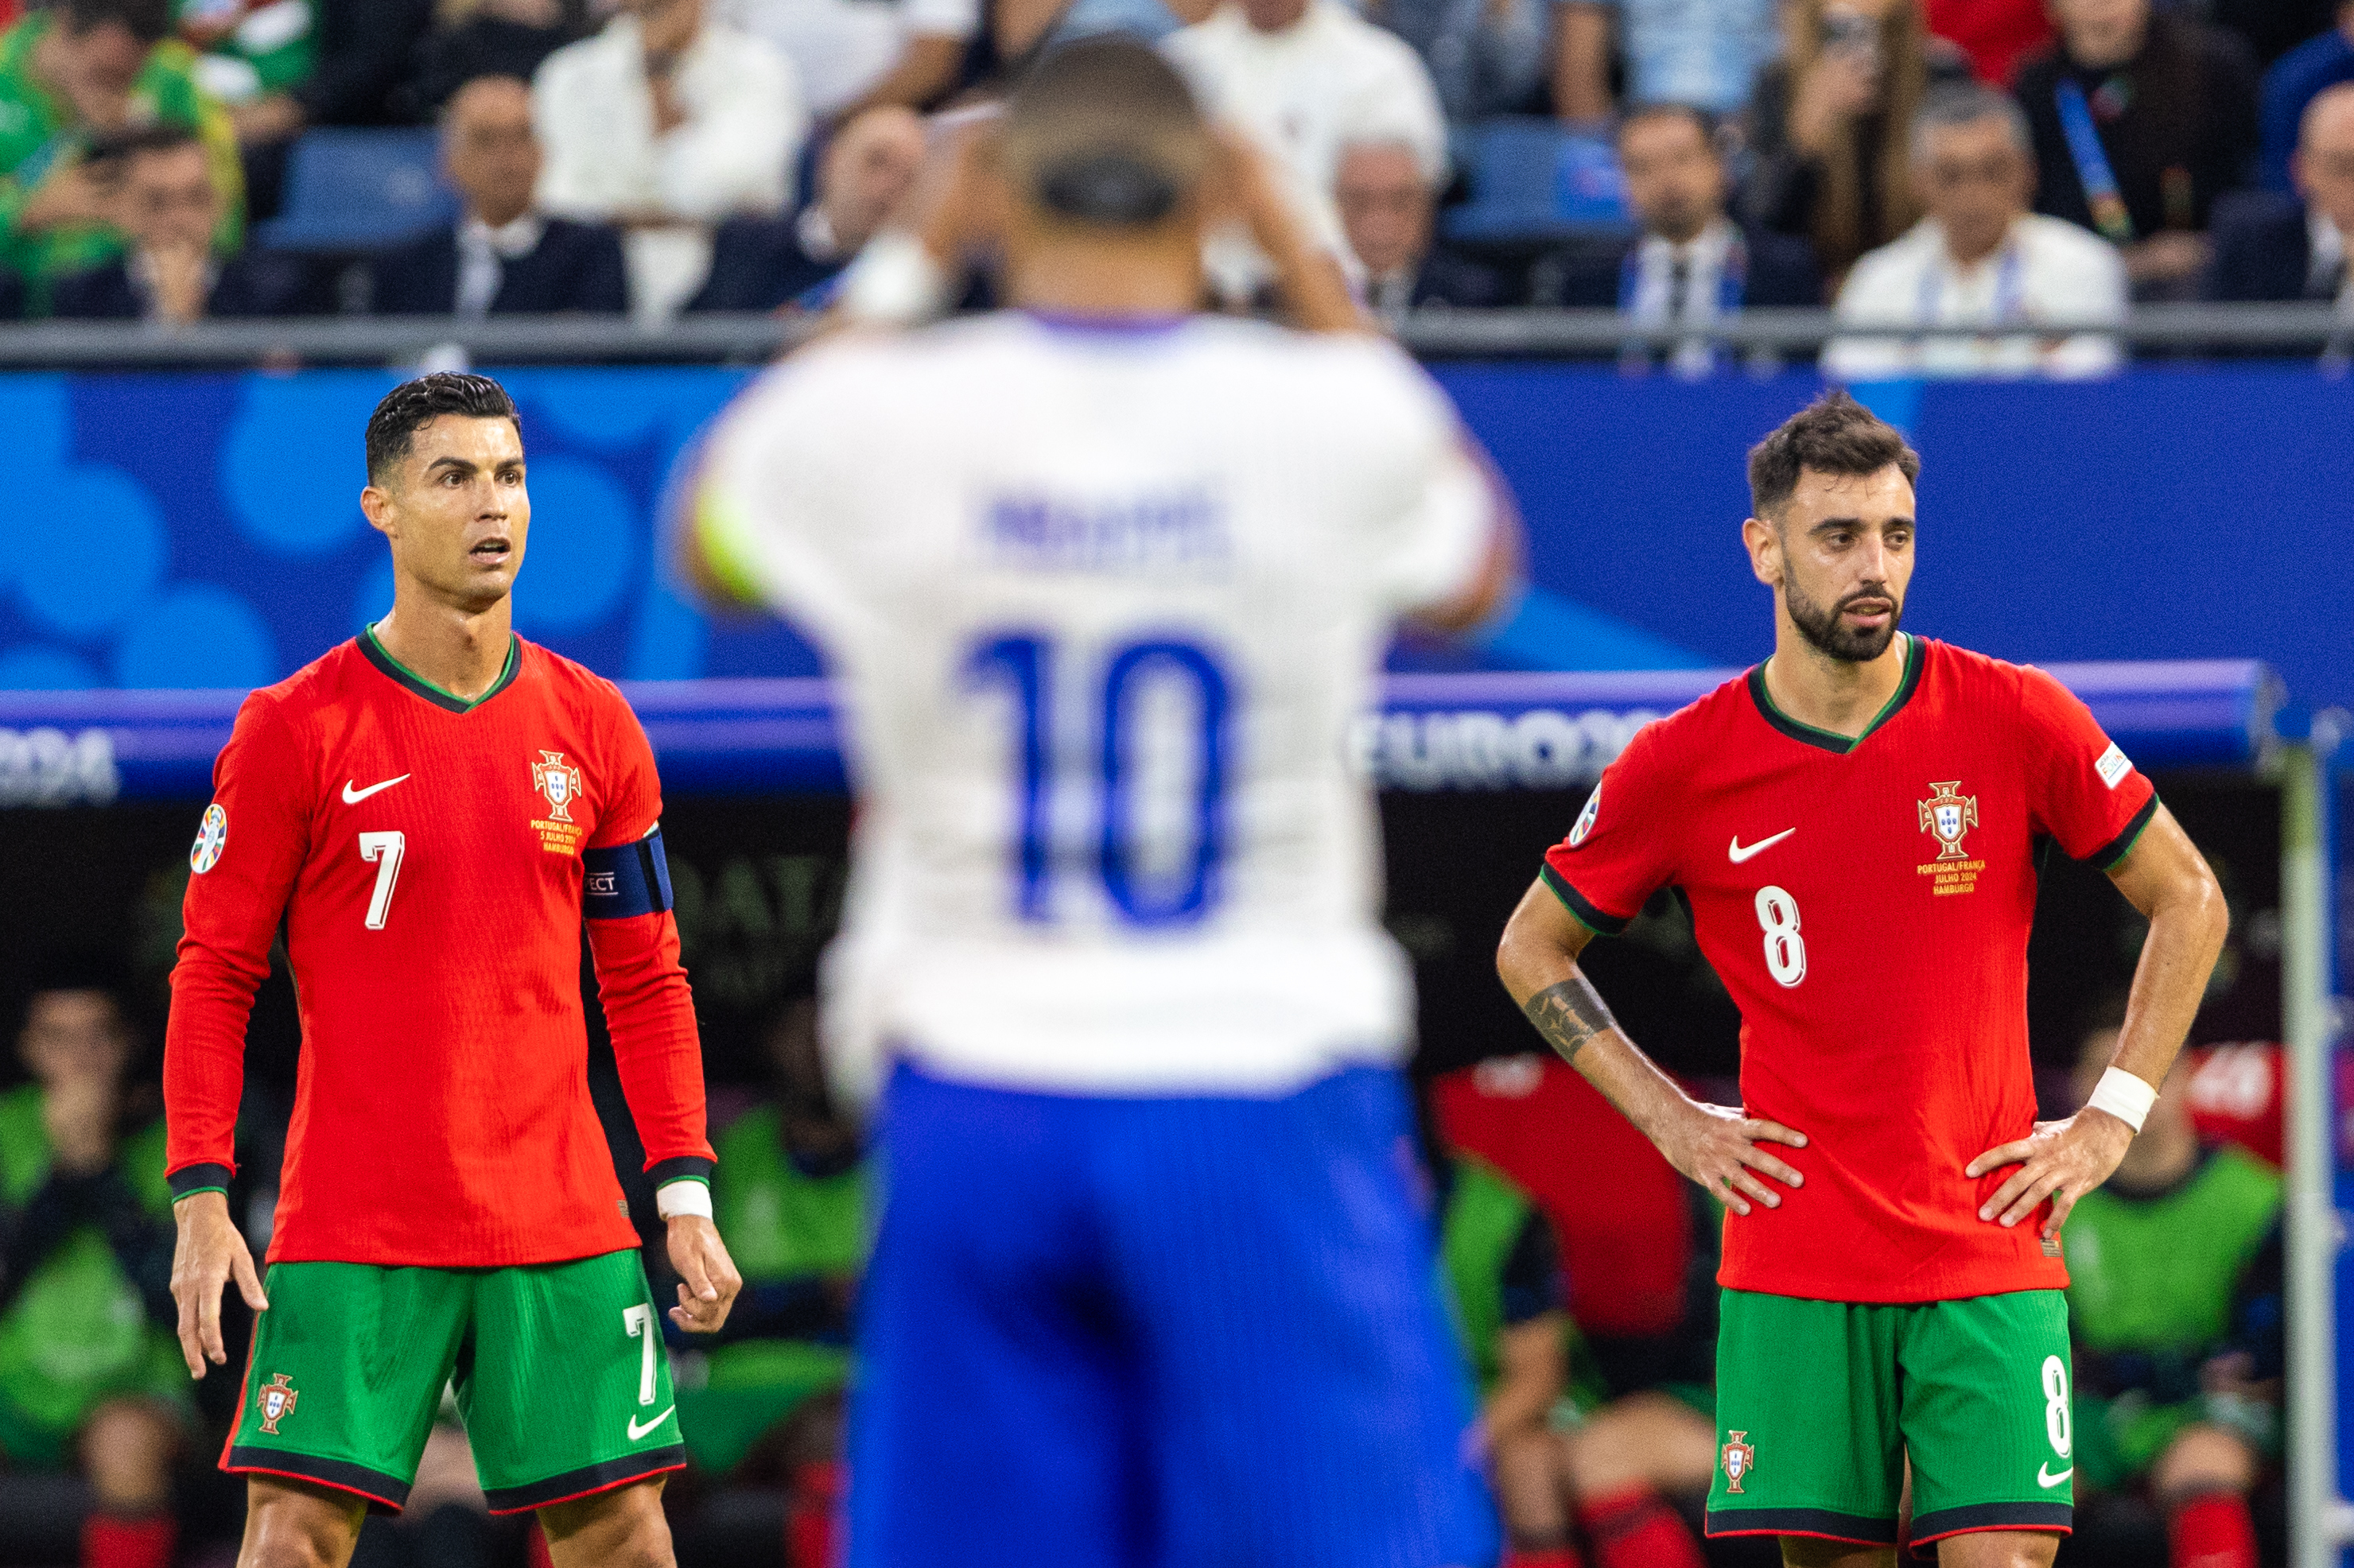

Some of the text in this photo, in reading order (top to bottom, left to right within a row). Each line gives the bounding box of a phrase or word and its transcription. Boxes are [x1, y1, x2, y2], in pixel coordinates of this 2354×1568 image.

[959, 625, 1239, 935] 10
[540, 830, 546, 840] 5
[546, 831, 565, 843] JULHO
[542, 841, 575, 856] HAMBURGO
[359, 831, 406, 930] 7
[1917, 860, 1985, 874] PORTUGAL/FRANÇA
[1933, 883, 1974, 895] HAMBURGO
[1936, 872, 1976, 883] JULHO 2024
[1755, 885, 1807, 987] 8
[622, 1302, 657, 1407] 7
[2041, 1354, 2071, 1458] 8
